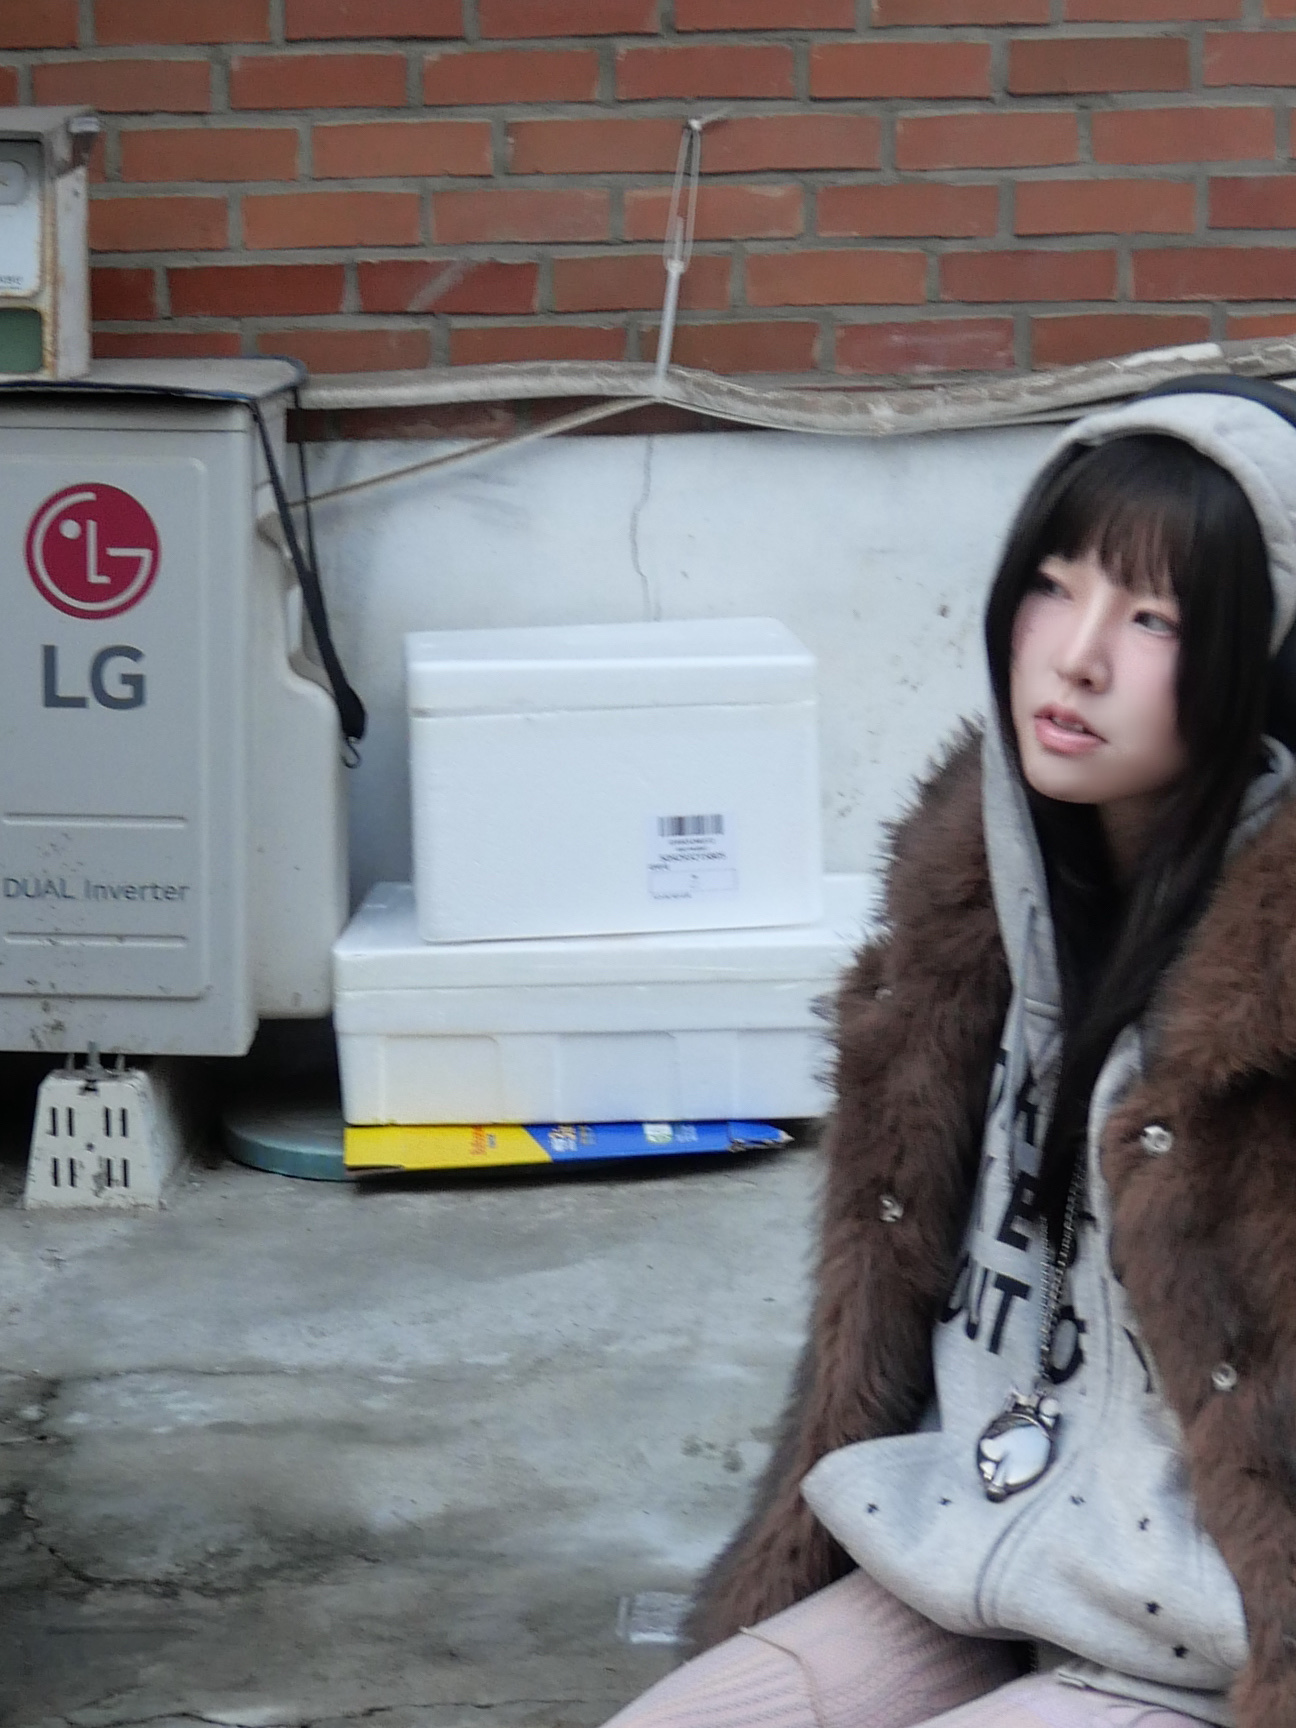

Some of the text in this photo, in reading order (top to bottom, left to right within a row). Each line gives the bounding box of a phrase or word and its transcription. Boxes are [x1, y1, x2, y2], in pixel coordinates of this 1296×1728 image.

[43, 644, 146, 710] LG
[2, 877, 190, 902] DUAL Inverter
